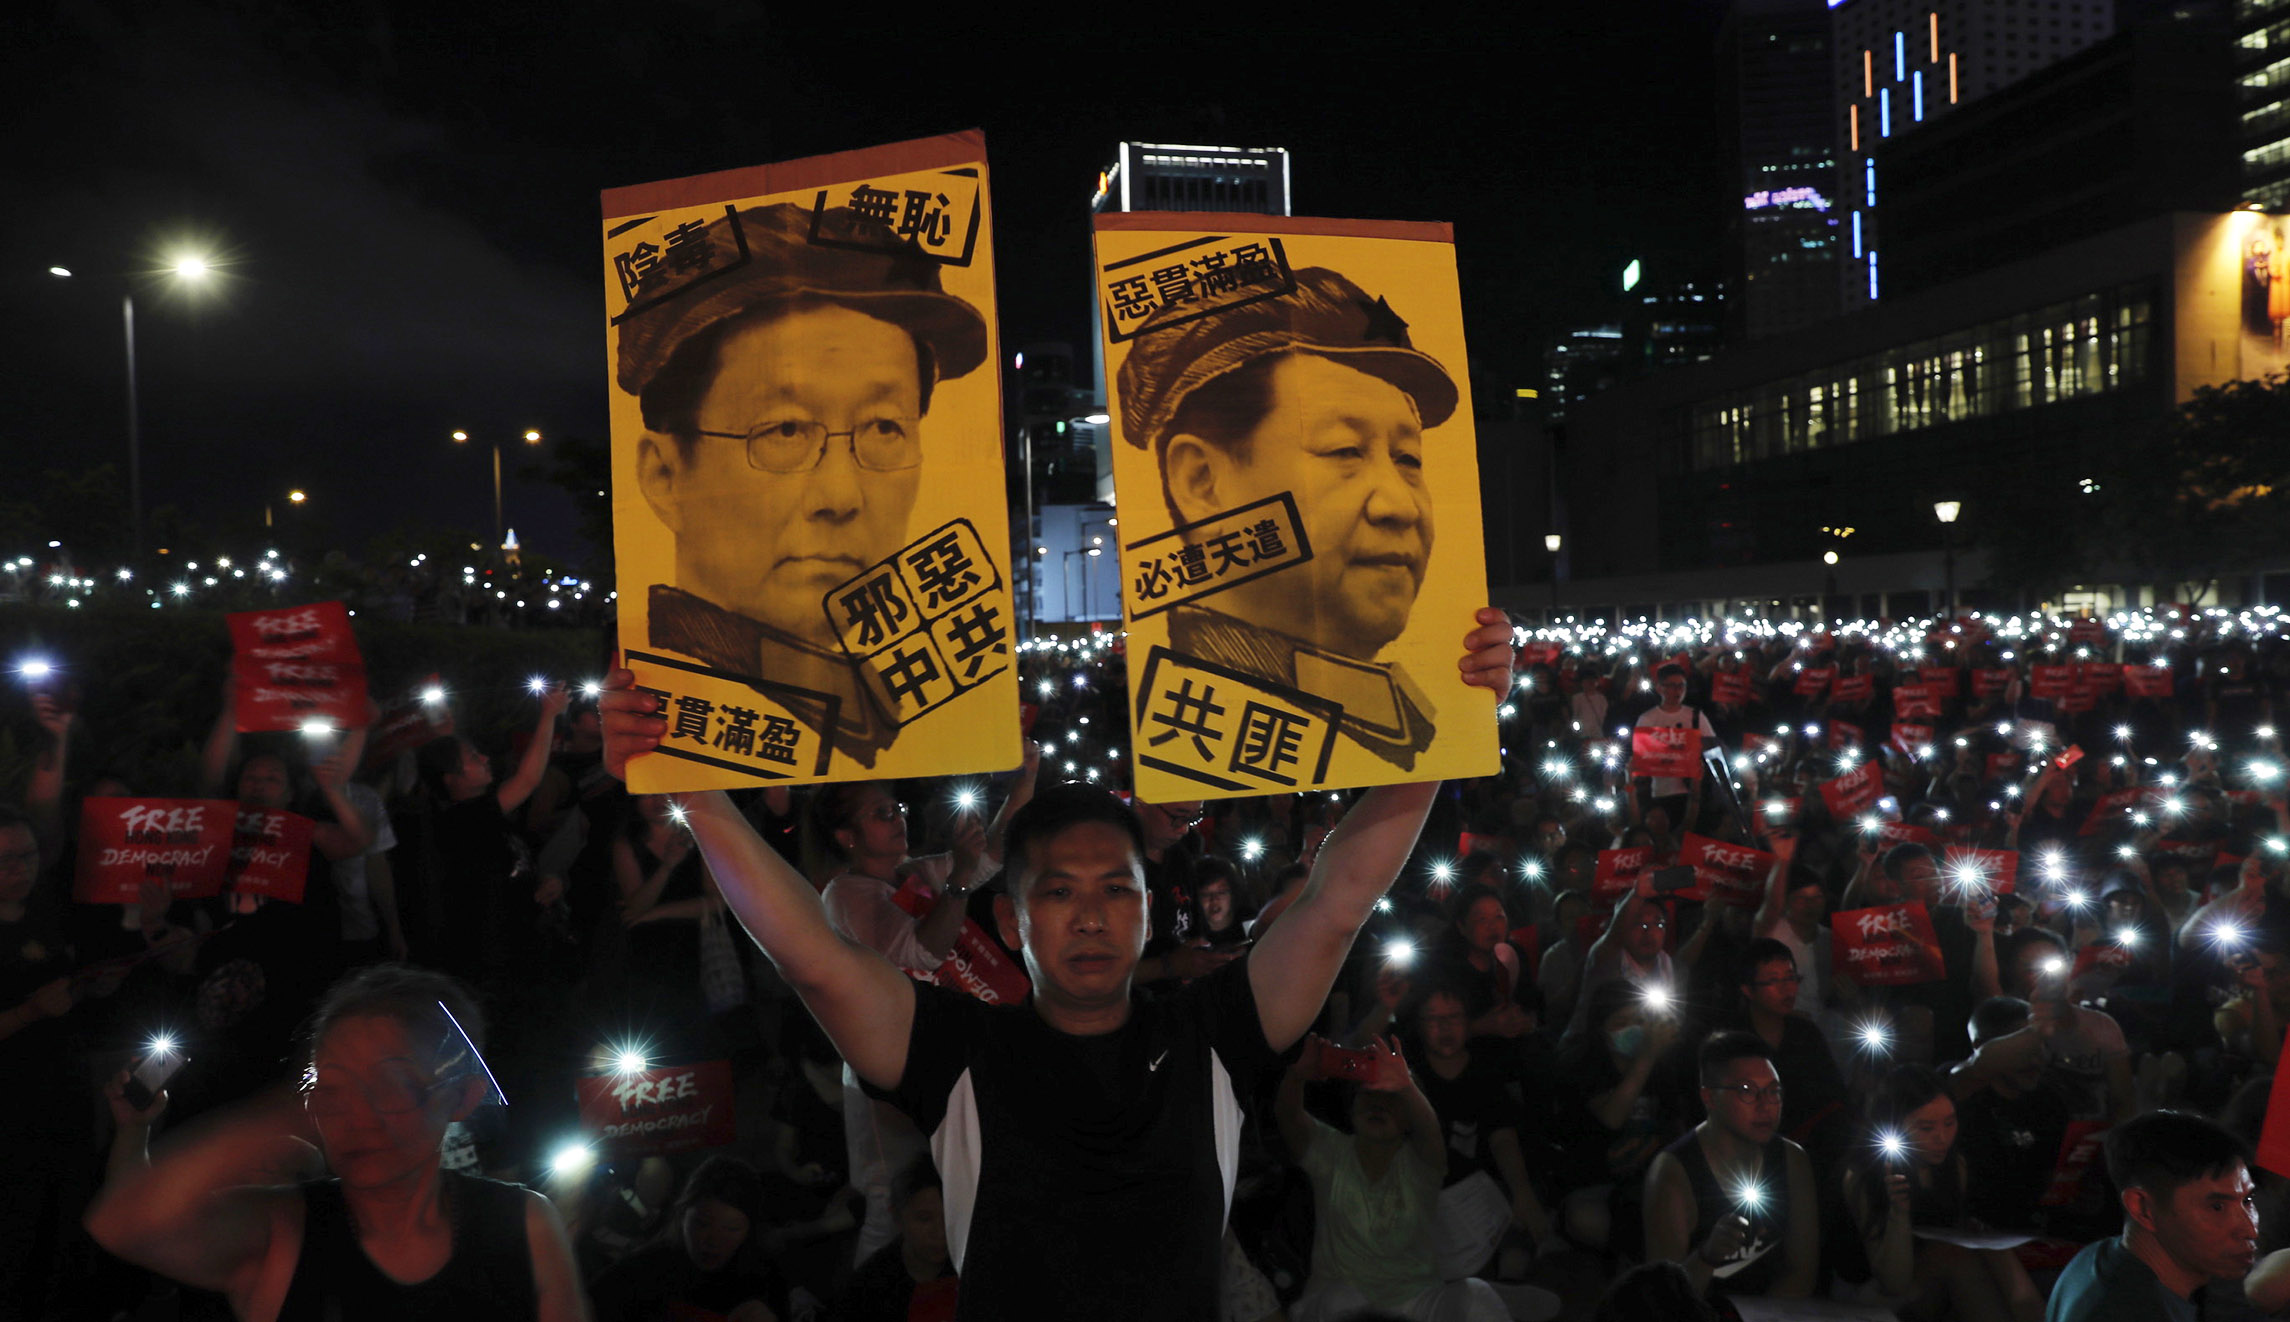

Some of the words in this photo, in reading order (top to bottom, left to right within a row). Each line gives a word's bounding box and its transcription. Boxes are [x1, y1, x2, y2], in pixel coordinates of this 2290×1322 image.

[848, 184, 952, 248] 無恥
[613, 218, 715, 304] 陰毒
[1108, 243, 1279, 321] 惡貫滿盈
[839, 531, 981, 646] 邪惡
[1134, 519, 1288, 602] 必遭天遣
[880, 602, 1009, 708] 中共
[1148, 678, 1311, 788] 共匪
[119, 805, 206, 834] FREE
[99, 845, 215, 867] DEMOCRACY
[1702, 844, 1756, 870] FREE
[1857, 908, 1912, 939] FREE
[604, 1103, 713, 1138] DEMOCRACY
[612, 1072, 699, 1112] FREE
